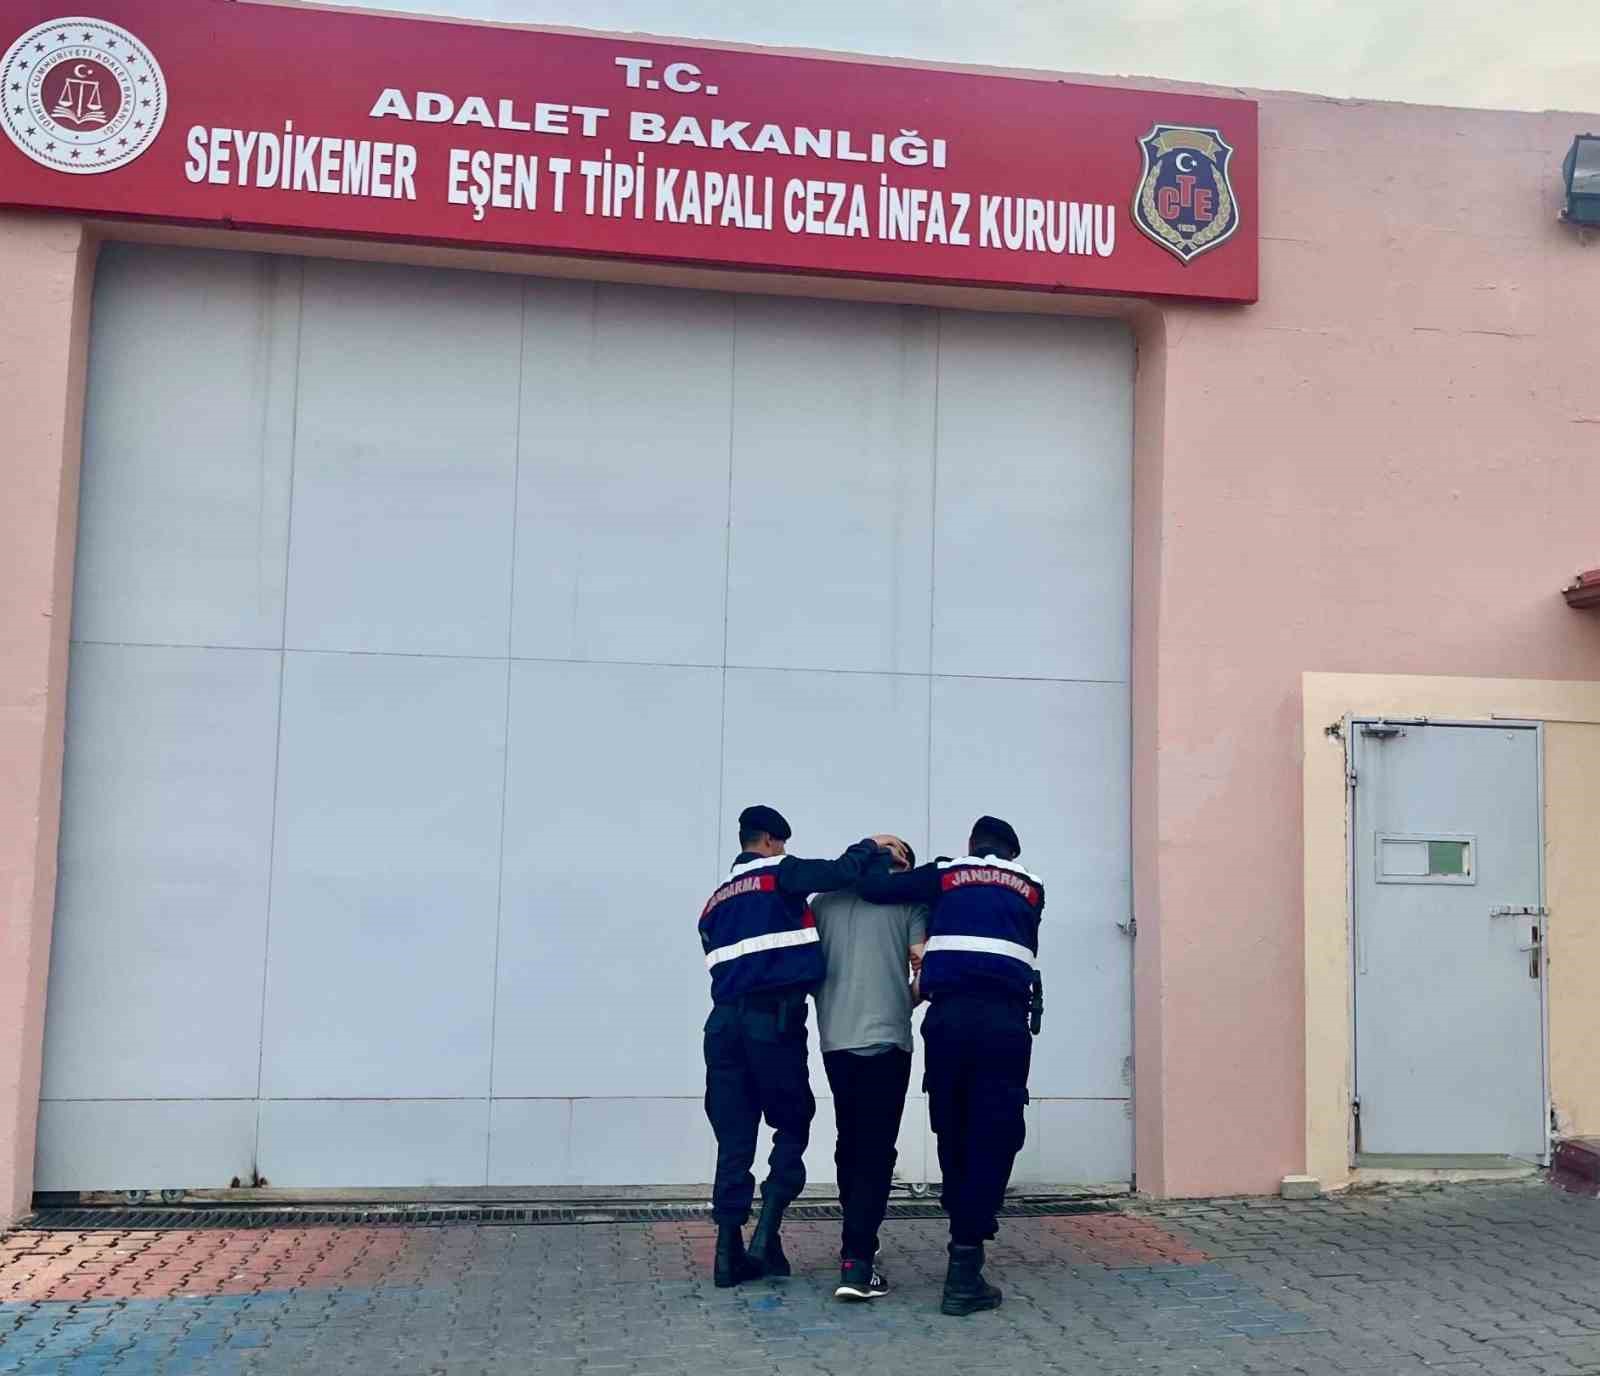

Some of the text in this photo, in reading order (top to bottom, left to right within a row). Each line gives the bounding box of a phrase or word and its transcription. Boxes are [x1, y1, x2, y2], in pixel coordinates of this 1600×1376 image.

[615, 56, 719, 95] T.C.
[369, 88, 947, 168] ADALET BAKANLIĞI
[184, 119, 1116, 258] SEYDİKEMER EŞEN T TİPİ KAPALI CEZA İNFAZ KURUMU
[952, 868, 1030, 898] JANDARMA
